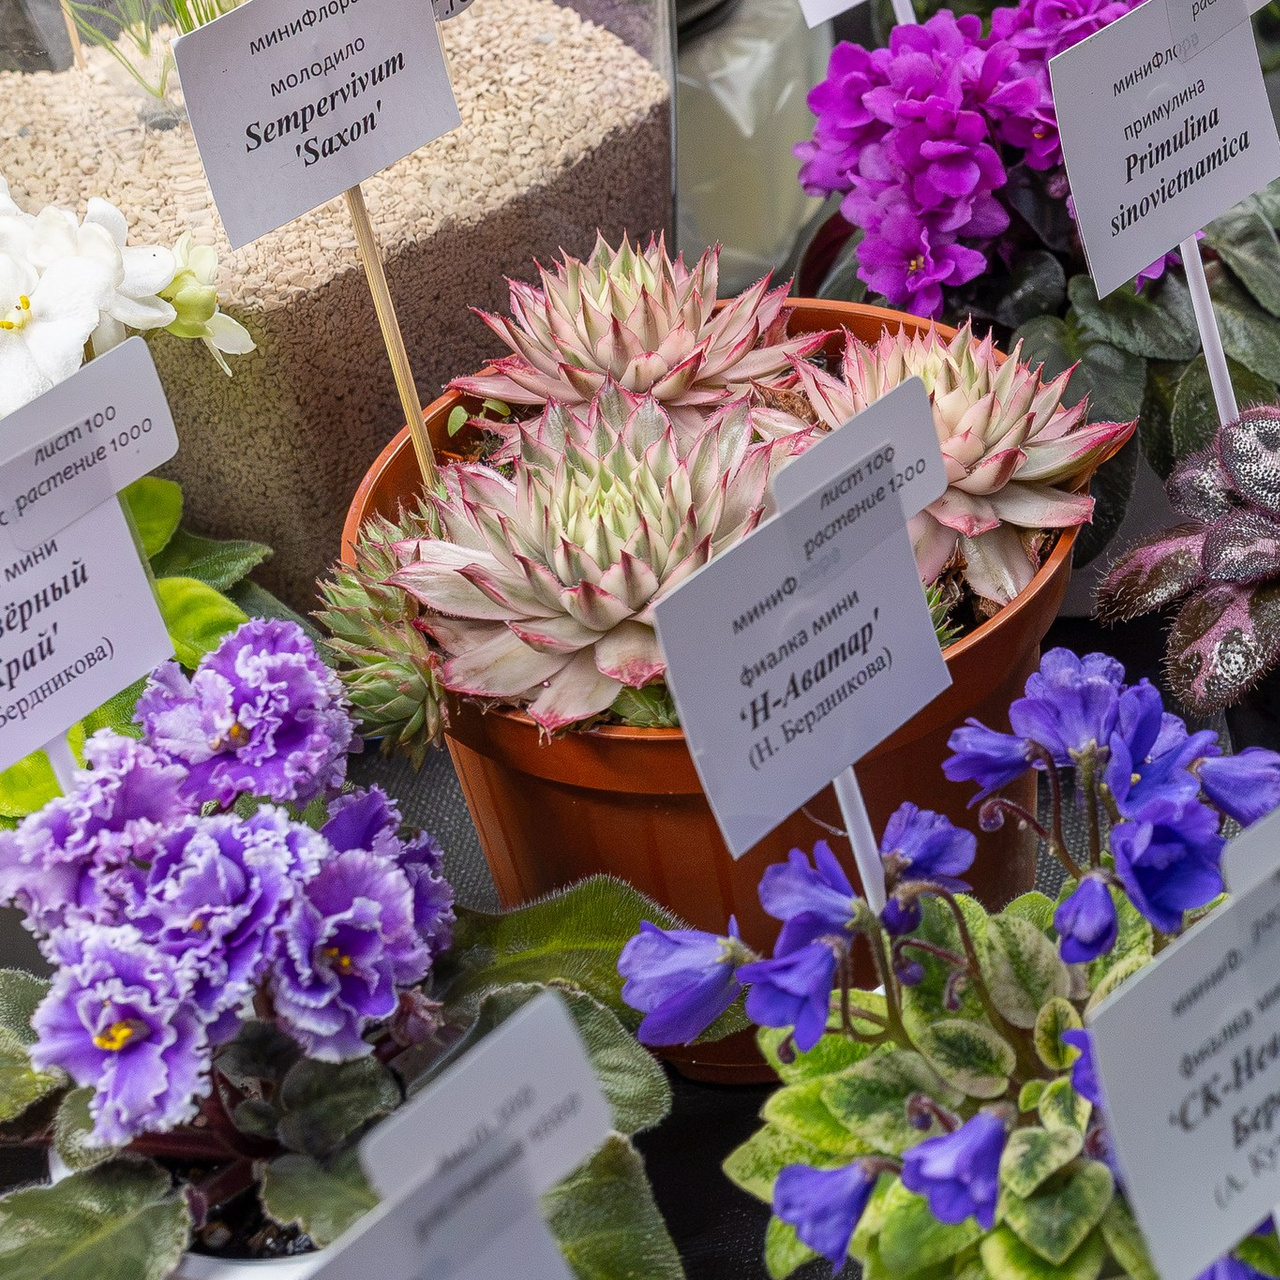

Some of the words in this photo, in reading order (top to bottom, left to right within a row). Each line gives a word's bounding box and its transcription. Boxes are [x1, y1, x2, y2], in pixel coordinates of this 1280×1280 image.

[245, 50, 405, 154] Sempervivum
[270, 36, 366, 98] молодило
[295, 99, 382, 169] 'Saxon'
[1123, 77, 1206, 141] примулина
[1123, 104, 1221, 184] Primulina
[1109, 126, 1252, 238] sinovietnamica
[14, 443, 108, 517] растение
[109, 417, 154, 452] 1000
[32, 426, 84, 468] лист
[84, 404, 118, 436] 100
[801, 486, 888, 562] растение
[888, 457, 928, 497] 1200
[819, 464, 865, 510] лист
[865, 444, 896, 477] 100
[4, 538, 59, 583] мини
[738, 628, 809, 690] фиалка
[811, 587, 861, 634] мини
[746, 736, 781, 772] (Н.
[781, 645, 895, 743] Бердникова)
